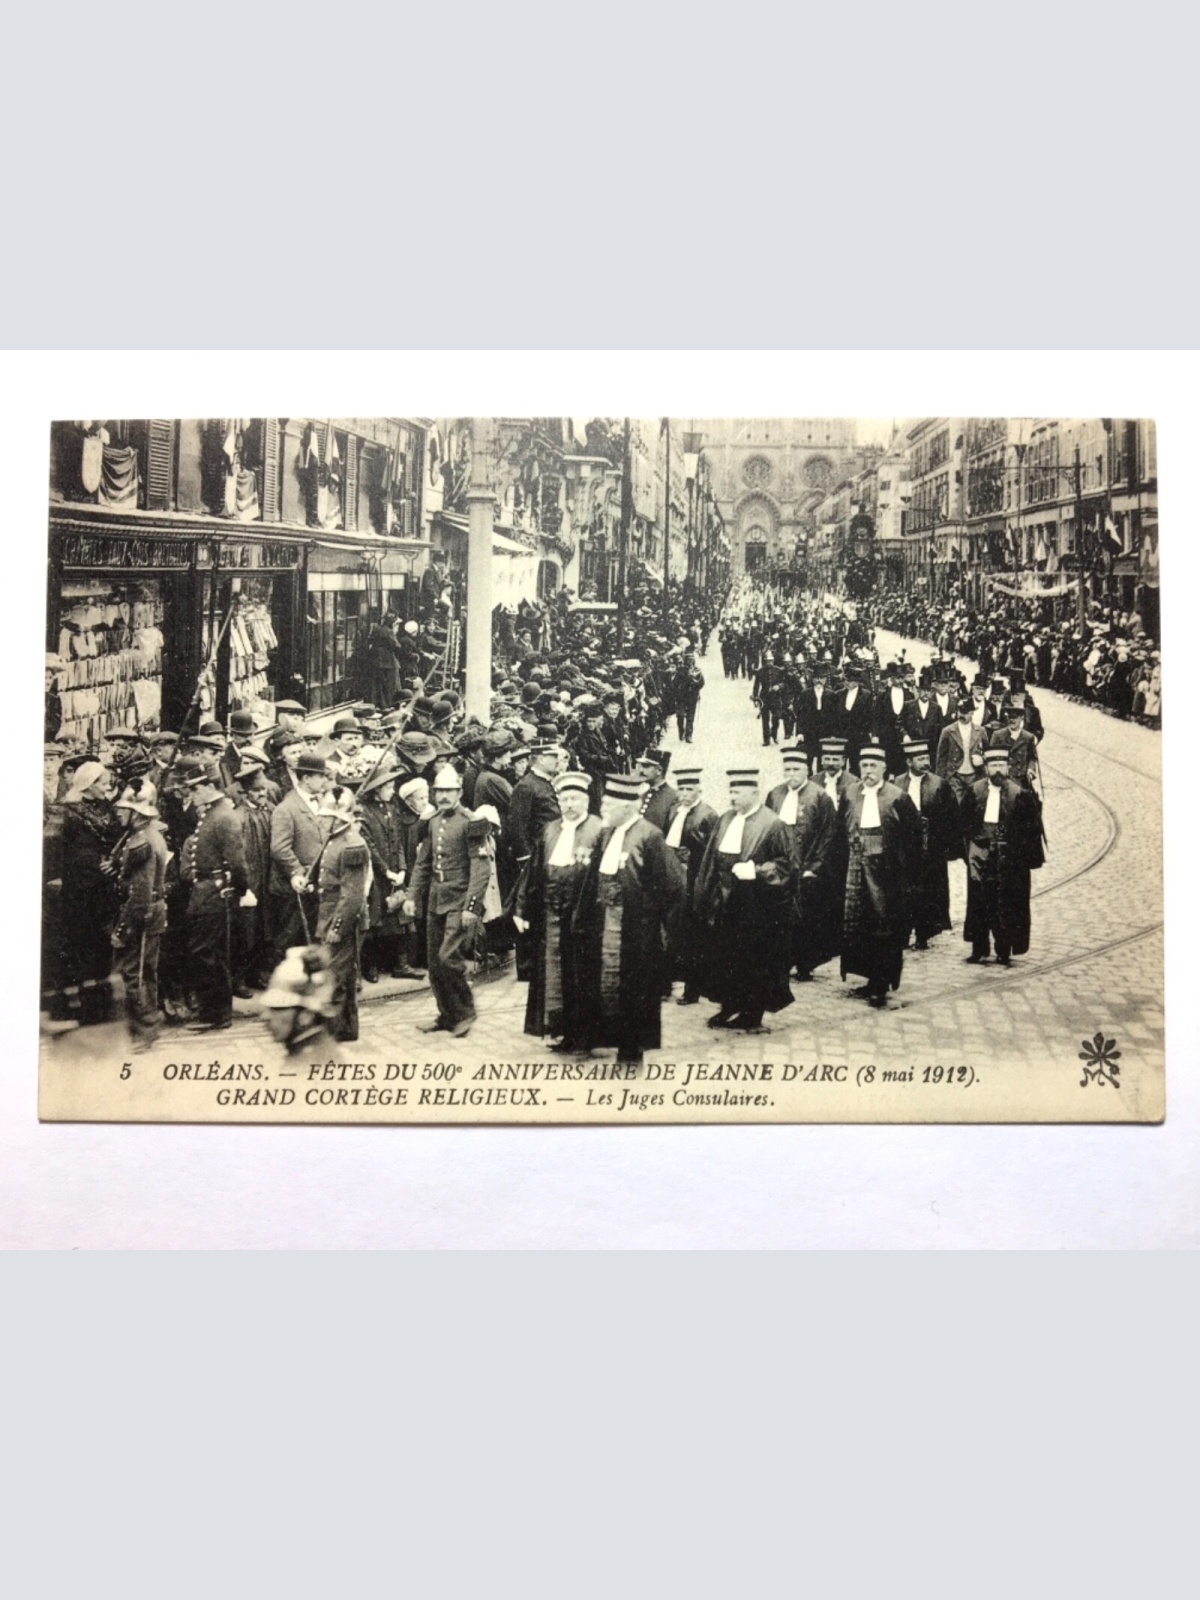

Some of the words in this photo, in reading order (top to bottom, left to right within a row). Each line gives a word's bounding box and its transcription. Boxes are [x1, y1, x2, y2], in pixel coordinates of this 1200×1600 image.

[119, 1062, 132, 1080] 5
[163, 1060, 269, 1081] ORLÉANS.
[307, 1060, 377, 1081] FÊTES
[383, 1063, 417, 1081] DU
[471, 1063, 637, 1081] ANNIVERSAIRE
[644, 1063, 676, 1081] DE
[681, 1063, 774, 1086] JEANNE
[780, 1064, 848, 1082] D'ARC
[856, 1065, 876, 1087] (8
[882, 1066, 914, 1083] mai
[922, 1065, 980, 1088] 1912).
[216, 1088, 296, 1106] GRAND
[304, 1085, 409, 1106] CORTÈGE
[417, 1088, 547, 1106] RELIGIEUX.
[586, 1089, 612, 1106] Les
[617, 1088, 665, 1111] Juges
[672, 1089, 775, 1107] Consulaires.
